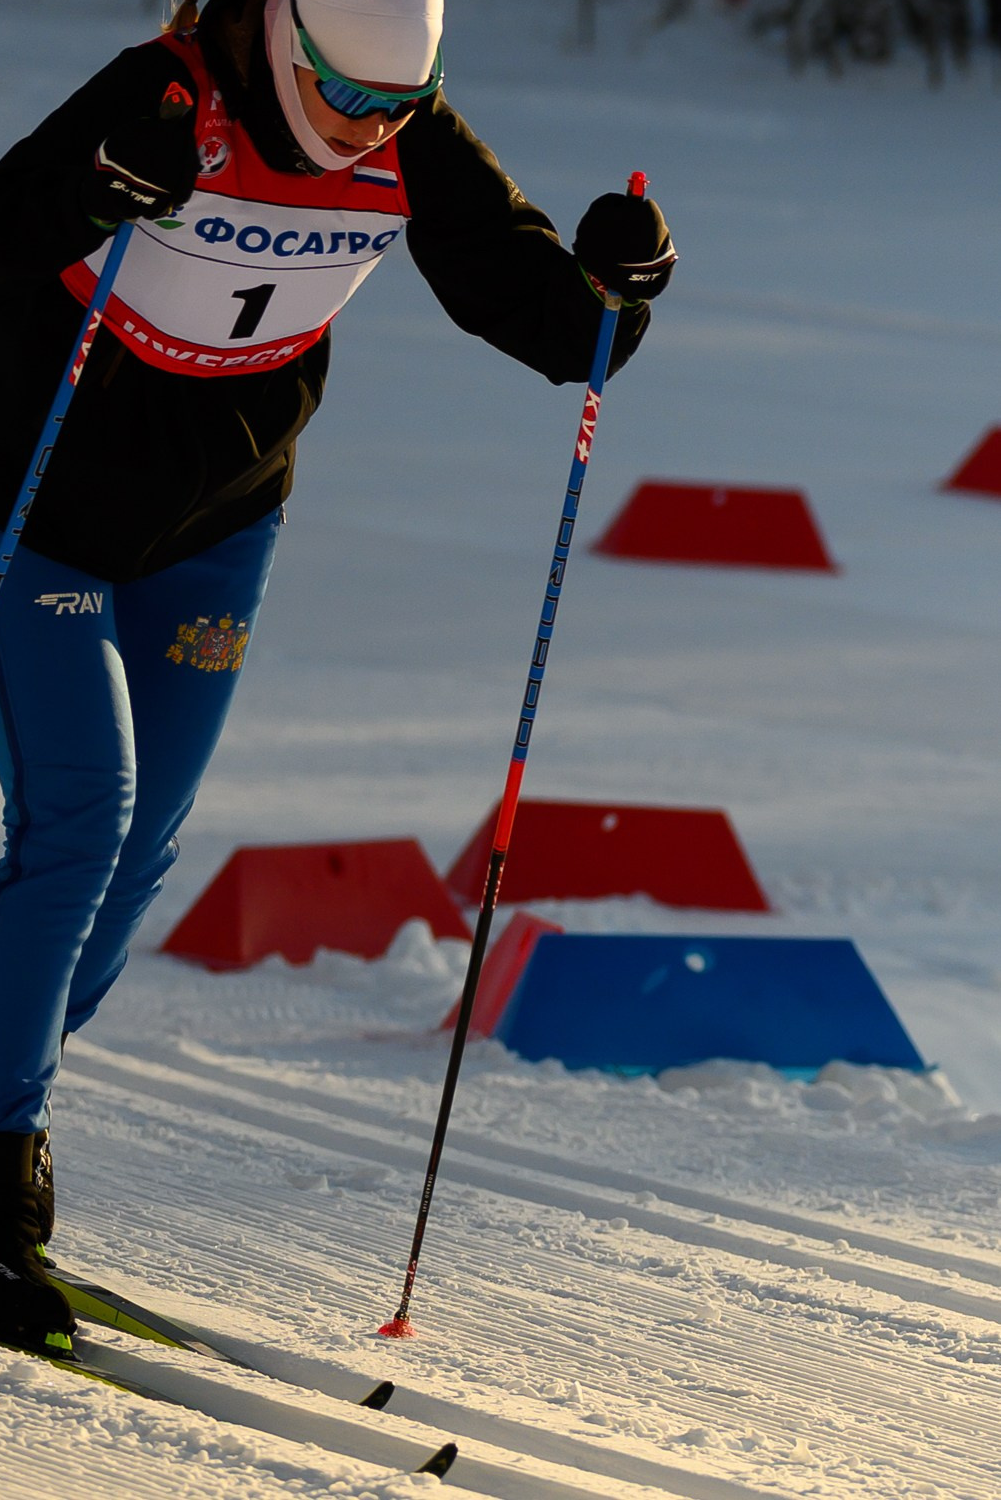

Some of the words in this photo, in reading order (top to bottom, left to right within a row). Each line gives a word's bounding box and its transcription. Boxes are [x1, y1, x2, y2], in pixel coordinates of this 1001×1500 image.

[194, 216, 399, 257] ФОСАГРО
[228, 283, 277, 339] 1
[575, 388, 601, 462] KV+
[35, 591, 104, 615] RAY
[516, 476, 585, 748] TORNADO
